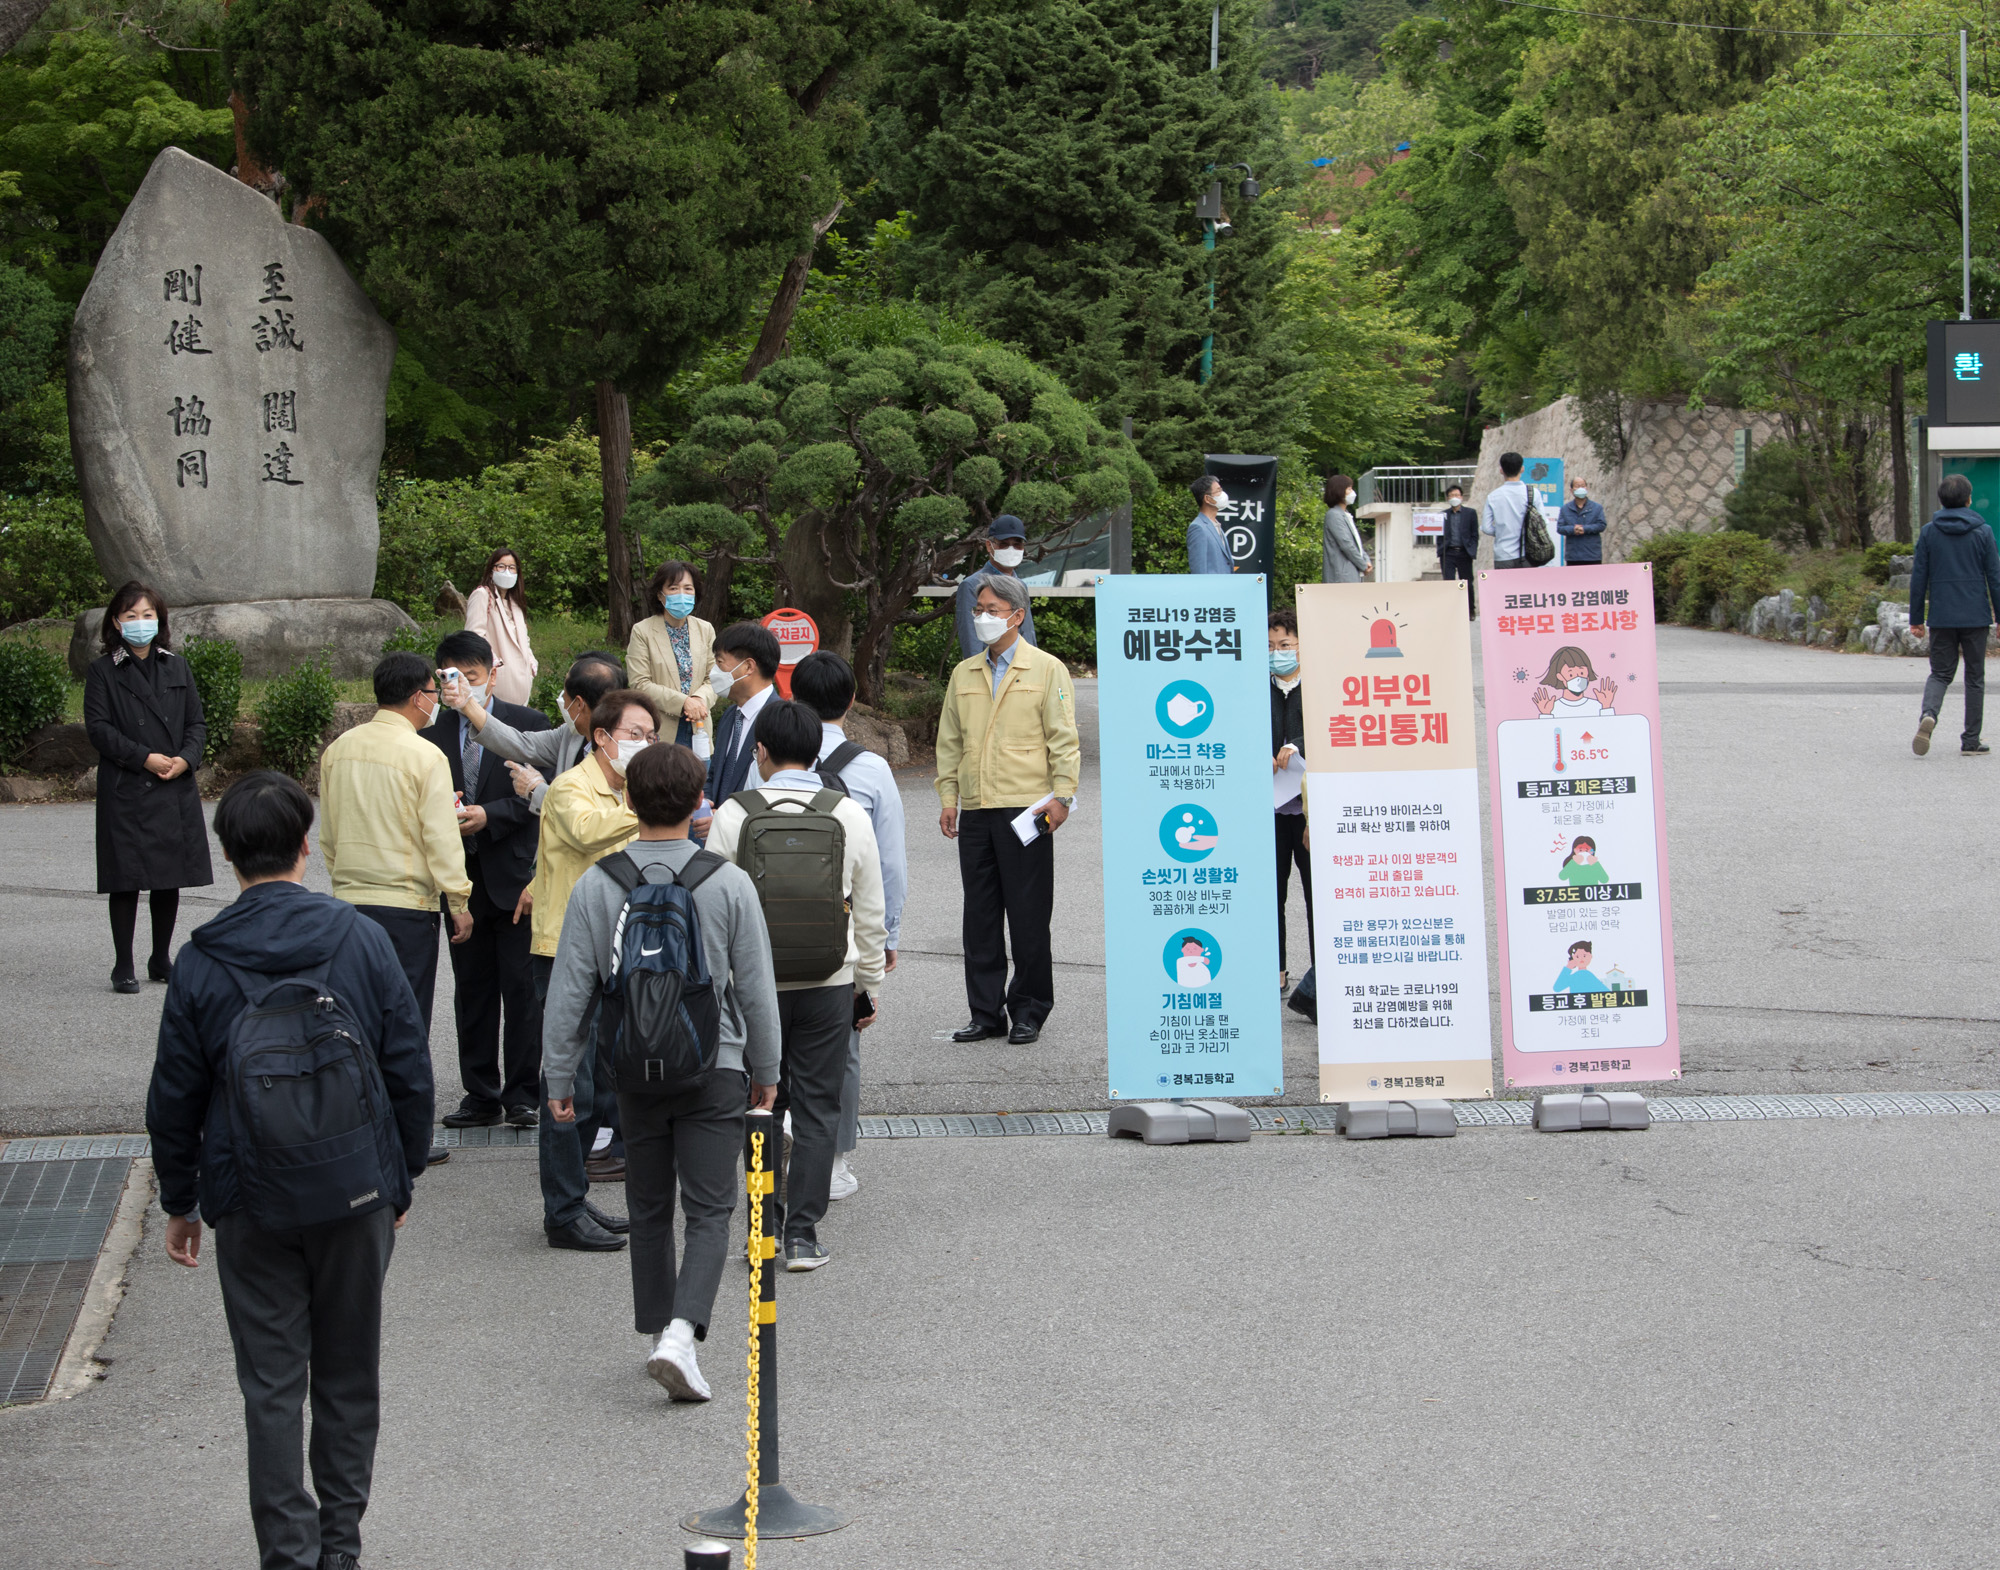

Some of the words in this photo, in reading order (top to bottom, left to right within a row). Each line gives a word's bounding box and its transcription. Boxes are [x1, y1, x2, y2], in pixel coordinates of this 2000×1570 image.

[163, 263, 213, 356] 剛健
[251, 261, 305, 354] 至誠
[166, 394, 213, 489] 協同
[261, 389, 305, 487] 闊達
[1216, 499, 1265, 522] 주차
[1233, 533, 1248, 553] P
[1504, 592, 1567, 610] 코로나19
[1571, 589, 1629, 607] 감염예방
[1127, 608, 1190, 623] 코로나19
[1193, 607, 1237, 623] 감염증
[1497, 614, 1555, 636] 학부모
[1561, 610, 1639, 634] 협조사항
[1123, 628, 1243, 662] 예방수칙
[1342, 674, 1432, 707] 외부인
[1328, 712, 1449, 747] 출입통제
[1146, 743, 1192, 760] 마스크
[1196, 743, 1227, 760] 착용
[1149, 765, 1190, 777] 교내에서
[1194, 765, 1225, 777] 마스크
[1159, 779, 1170, 790] 꼭
[1173, 778, 1215, 790] 착용하기
[1525, 782, 1553, 797] 등교
[1556, 780, 1570, 795] 전
[1574, 778, 1628, 795] 체온측정
[1342, 805, 1388, 818] 코로나19
[1390, 804, 1443, 816] 바이러스의
[1541, 802, 1561, 814] 등교
[1564, 801, 1574, 812] 전
[1576, 799, 1615, 812] 가정에서
[1336, 822, 1358, 834] 교내
[1360, 821, 1381, 833] 확산
[1384, 820, 1416, 833] 방지를
[1419, 820, 1451, 832] 위하여
[1553, 814, 1582, 826] 체온을
[1584, 813, 1604, 825] 측정
[1332, 854, 1364, 867] 학생과
[1367, 854, 1388, 866] 교사
[1391, 853, 1412, 865] 이외
[1415, 852, 1457, 864] 방문객의
[1141, 868, 1187, 885] 손씻기
[1192, 867, 1239, 884] 생활화
[1368, 870, 1389, 882] 교내
[1392, 869, 1424, 882] 출입을
[1149, 890, 1173, 902] 30초
[1176, 890, 1198, 902] 이상
[1200, 889, 1232, 901] 비누로
[1334, 887, 1365, 899] 엄격히
[1368, 886, 1411, 898] 금지하고
[1414, 884, 1460, 897] 있습니다.
[1536, 887, 1580, 902] 37.5도
[1584, 886, 1612, 901] 이상
[1615, 885, 1629, 900] 시
[1152, 904, 1195, 916] 꼼꼼하게
[1198, 903, 1230, 915] 손씻기
[1546, 908, 1576, 920] 발열이
[1579, 907, 1599, 919] 있는
[1601, 906, 1621, 918] 경우
[1342, 920, 1364, 931] 급한
[1366, 919, 1398, 931] 용무가
[1401, 917, 1454, 930] 있으신분은
[1548, 920, 1598, 933] 담임교사에
[1600, 919, 1620, 931] 연락
[1333, 936, 1354, 948] 정문
[1357, 934, 1441, 947] 배움터지킴이실을
[1444, 933, 1466, 945] 통해
[1337, 952, 1369, 965] 안내를
[1372, 951, 1414, 963] 받으시길
[1417, 950, 1463, 963] 바랍니다.
[1344, 985, 1365, 997] 저희
[1368, 984, 1400, 996] 학교는
[1403, 983, 1459, 996] 코로나19의
[1162, 993, 1223, 1010] 기침예절
[1352, 1001, 1373, 1013] 교내
[1376, 1000, 1429, 1013] 감염예방을
[1431, 999, 1453, 1011] 위해
[1541, 996, 1569, 1011] 등교
[1573, 994, 1587, 1009] 후
[1590, 993, 1618, 1008] 발열
[1621, 992, 1635, 1006] 시
[1160, 1015, 1191, 1027] 기침이
[1194, 1015, 1215, 1027] 나올
[1218, 1014, 1229, 1026] 땐
[1352, 1017, 1384, 1029] 최선을
[1387, 1016, 1454, 1029] 다하겠습니다.
[1557, 1014, 1586, 1027] 가정에
[1589, 1013, 1609, 1025] 연락
[1612, 1013, 1622, 1024] 후
[1149, 1028, 1171, 1041] 손이
[1174, 1028, 1195, 1040] 아닌
[1198, 1028, 1240, 1040] 옷소매로
[1580, 1027, 1600, 1039] 조퇴
[1160, 1042, 1182, 1054] 입과
[1184, 1043, 1195, 1054] 코
[1198, 1041, 1230, 1054] 가리기
[1568, 1059, 1631, 1073] 경복고등학교
[1173, 1073, 1235, 1085] 경복고등학교
[1383, 1076, 1445, 1088] 경복고등학교
